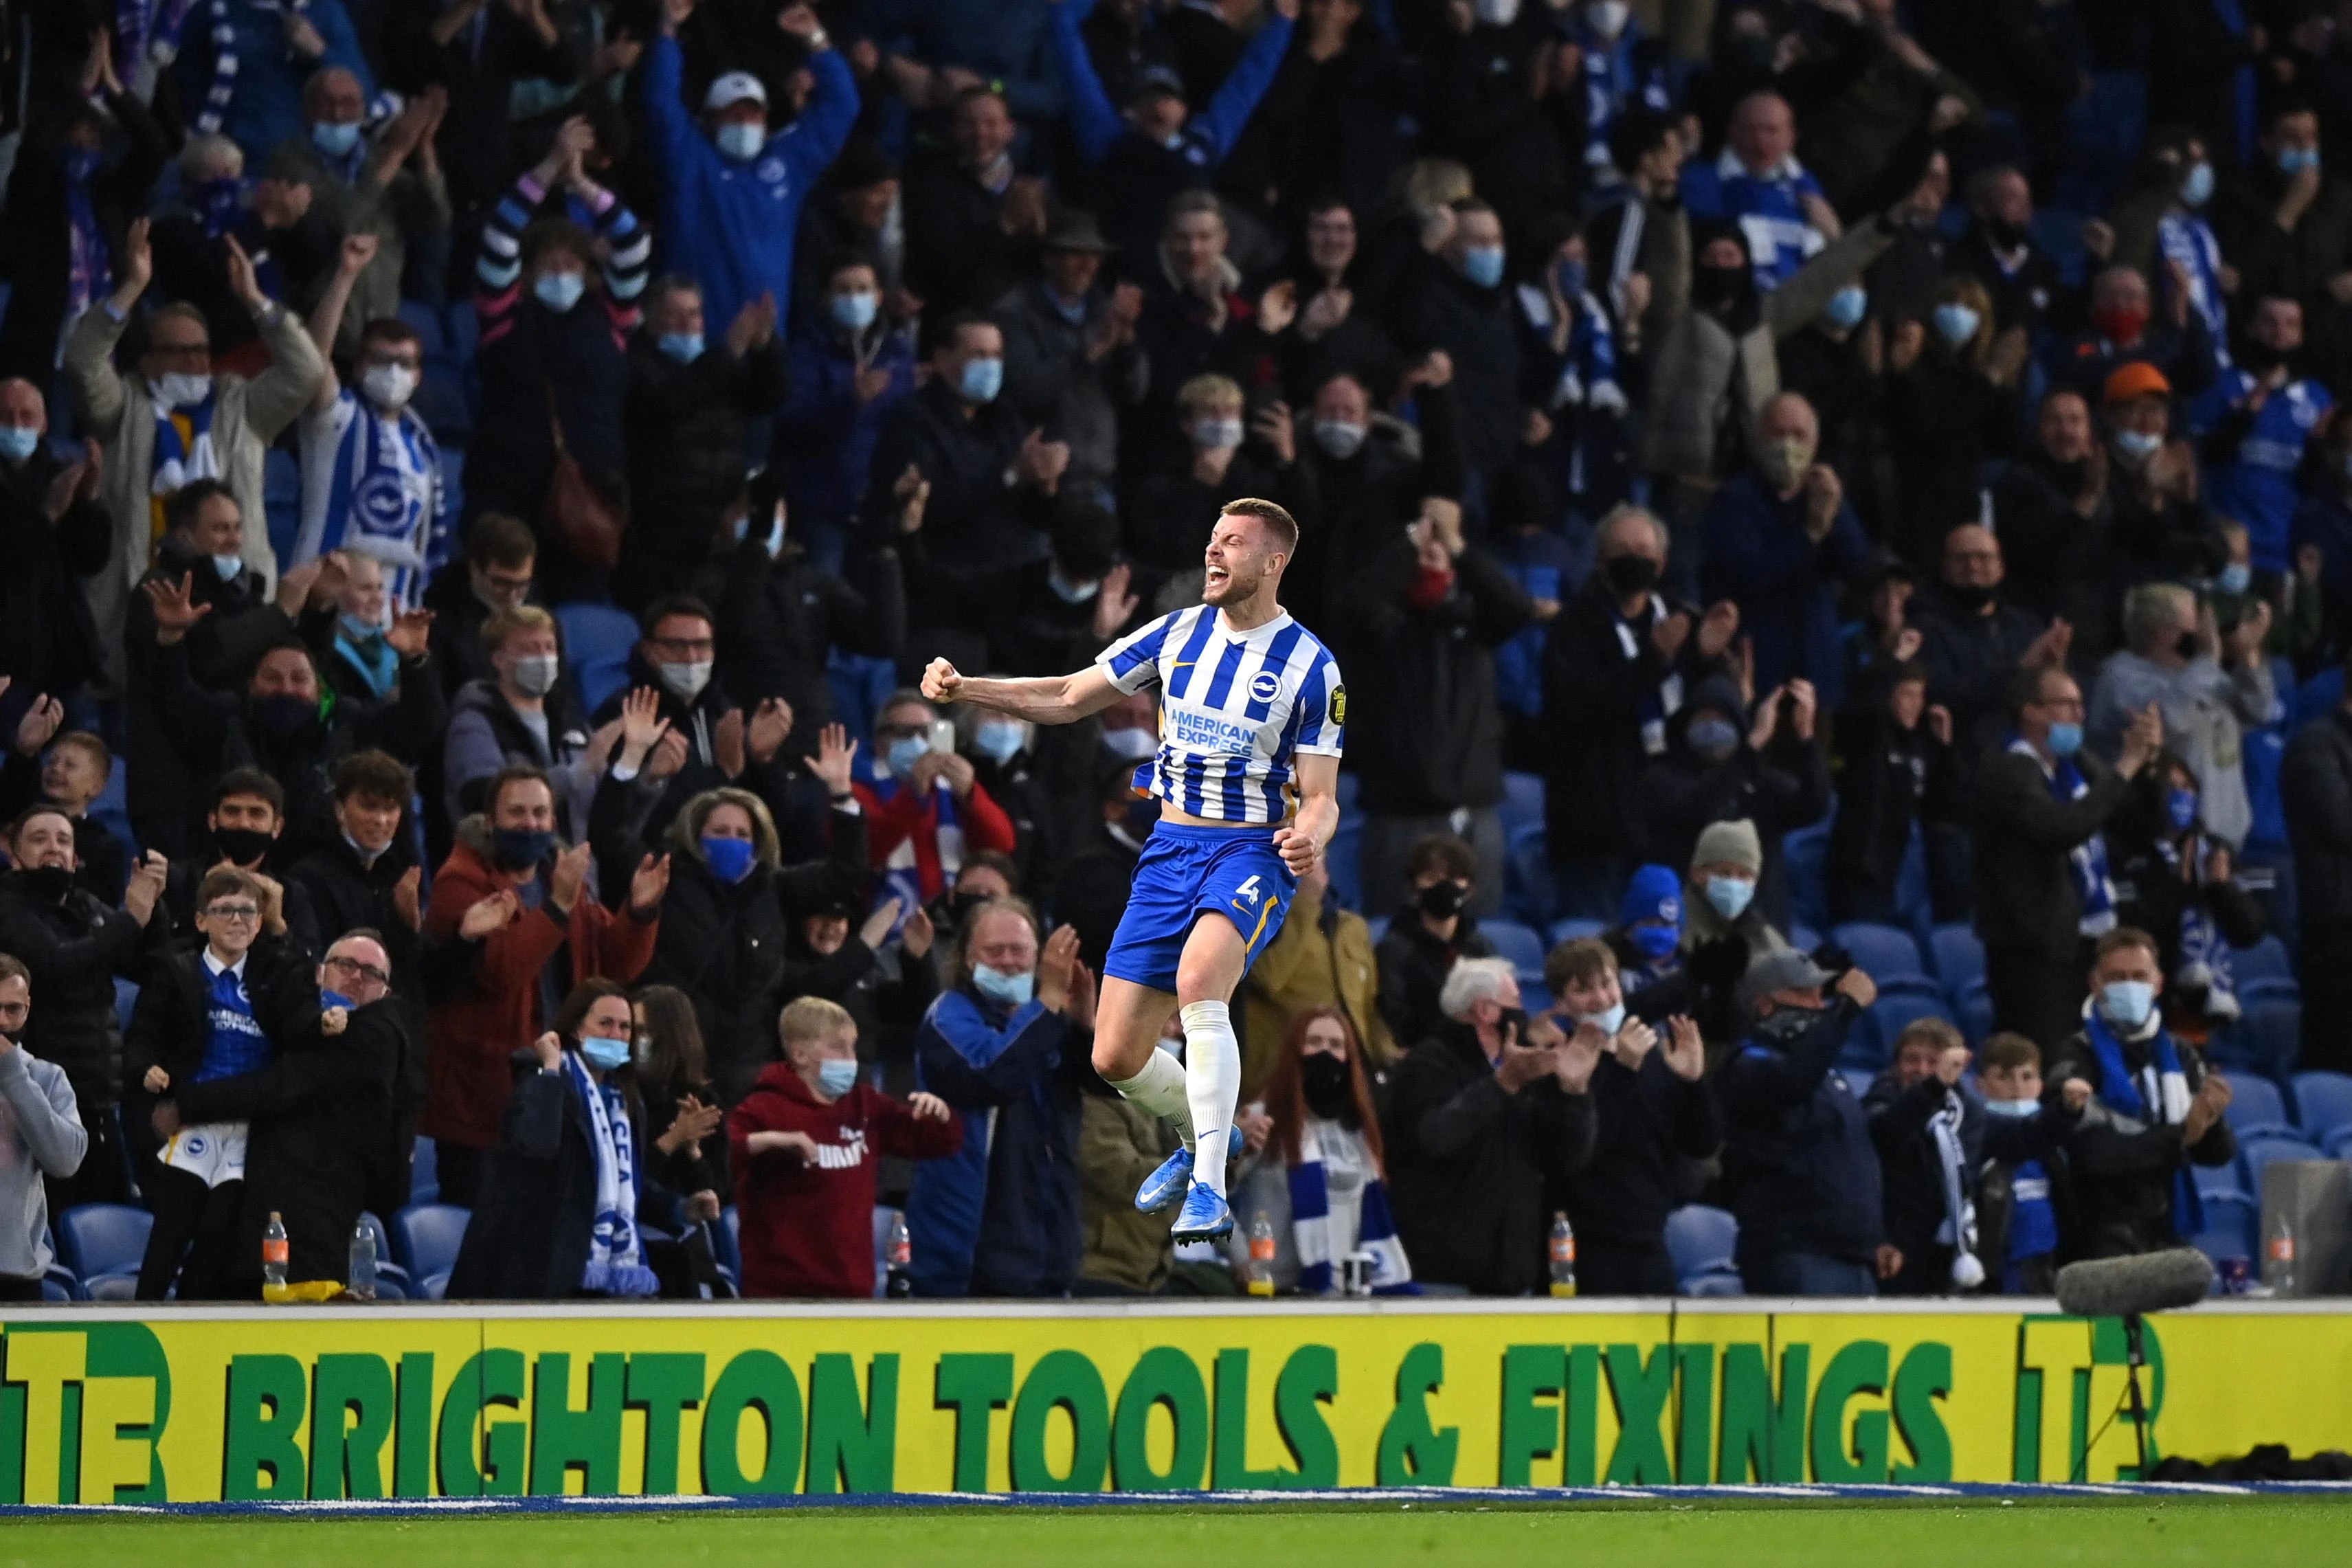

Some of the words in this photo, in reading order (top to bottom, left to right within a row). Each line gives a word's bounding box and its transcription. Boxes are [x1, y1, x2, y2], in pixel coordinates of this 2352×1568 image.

[1172, 708, 1257, 743] AMERICAN
[1177, 726, 1253, 757] EXPRESS
[1235, 875, 1261, 906] 4
[803, 1142, 862, 1169] UMA
[222, 1348, 900, 1501] BRIGHTON
[934, 1343, 1339, 1492] TOOLS
[1376, 1342, 1459, 1487] &
[1498, 1340, 1953, 1486] FIXINGS
